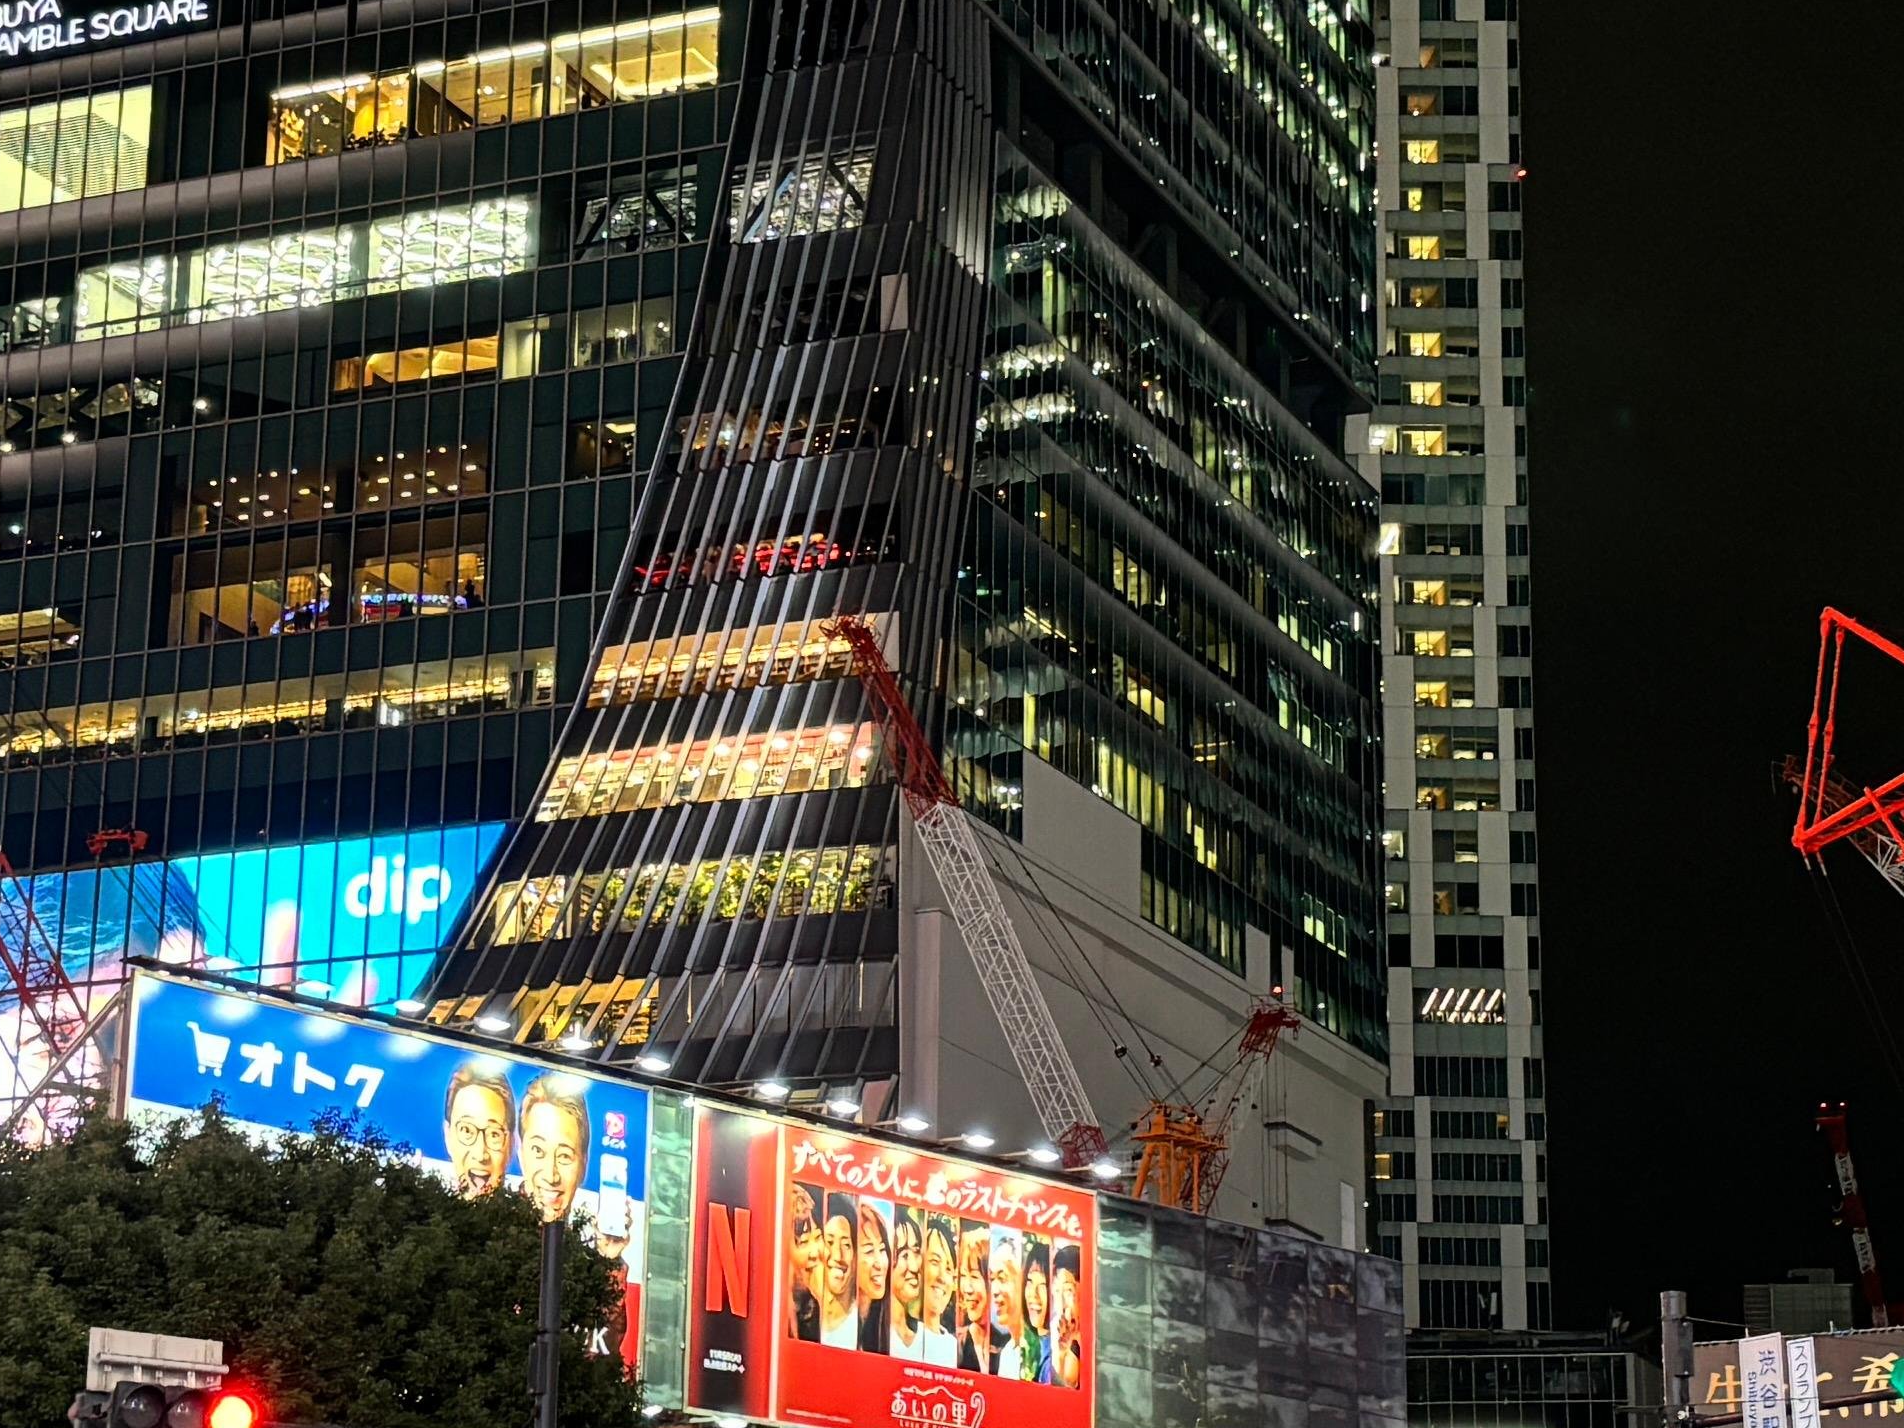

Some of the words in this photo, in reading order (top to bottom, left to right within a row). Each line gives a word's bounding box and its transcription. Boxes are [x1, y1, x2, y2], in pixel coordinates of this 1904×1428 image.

[344, 854, 452, 925] dip
[239, 1041, 385, 1109] オトク
